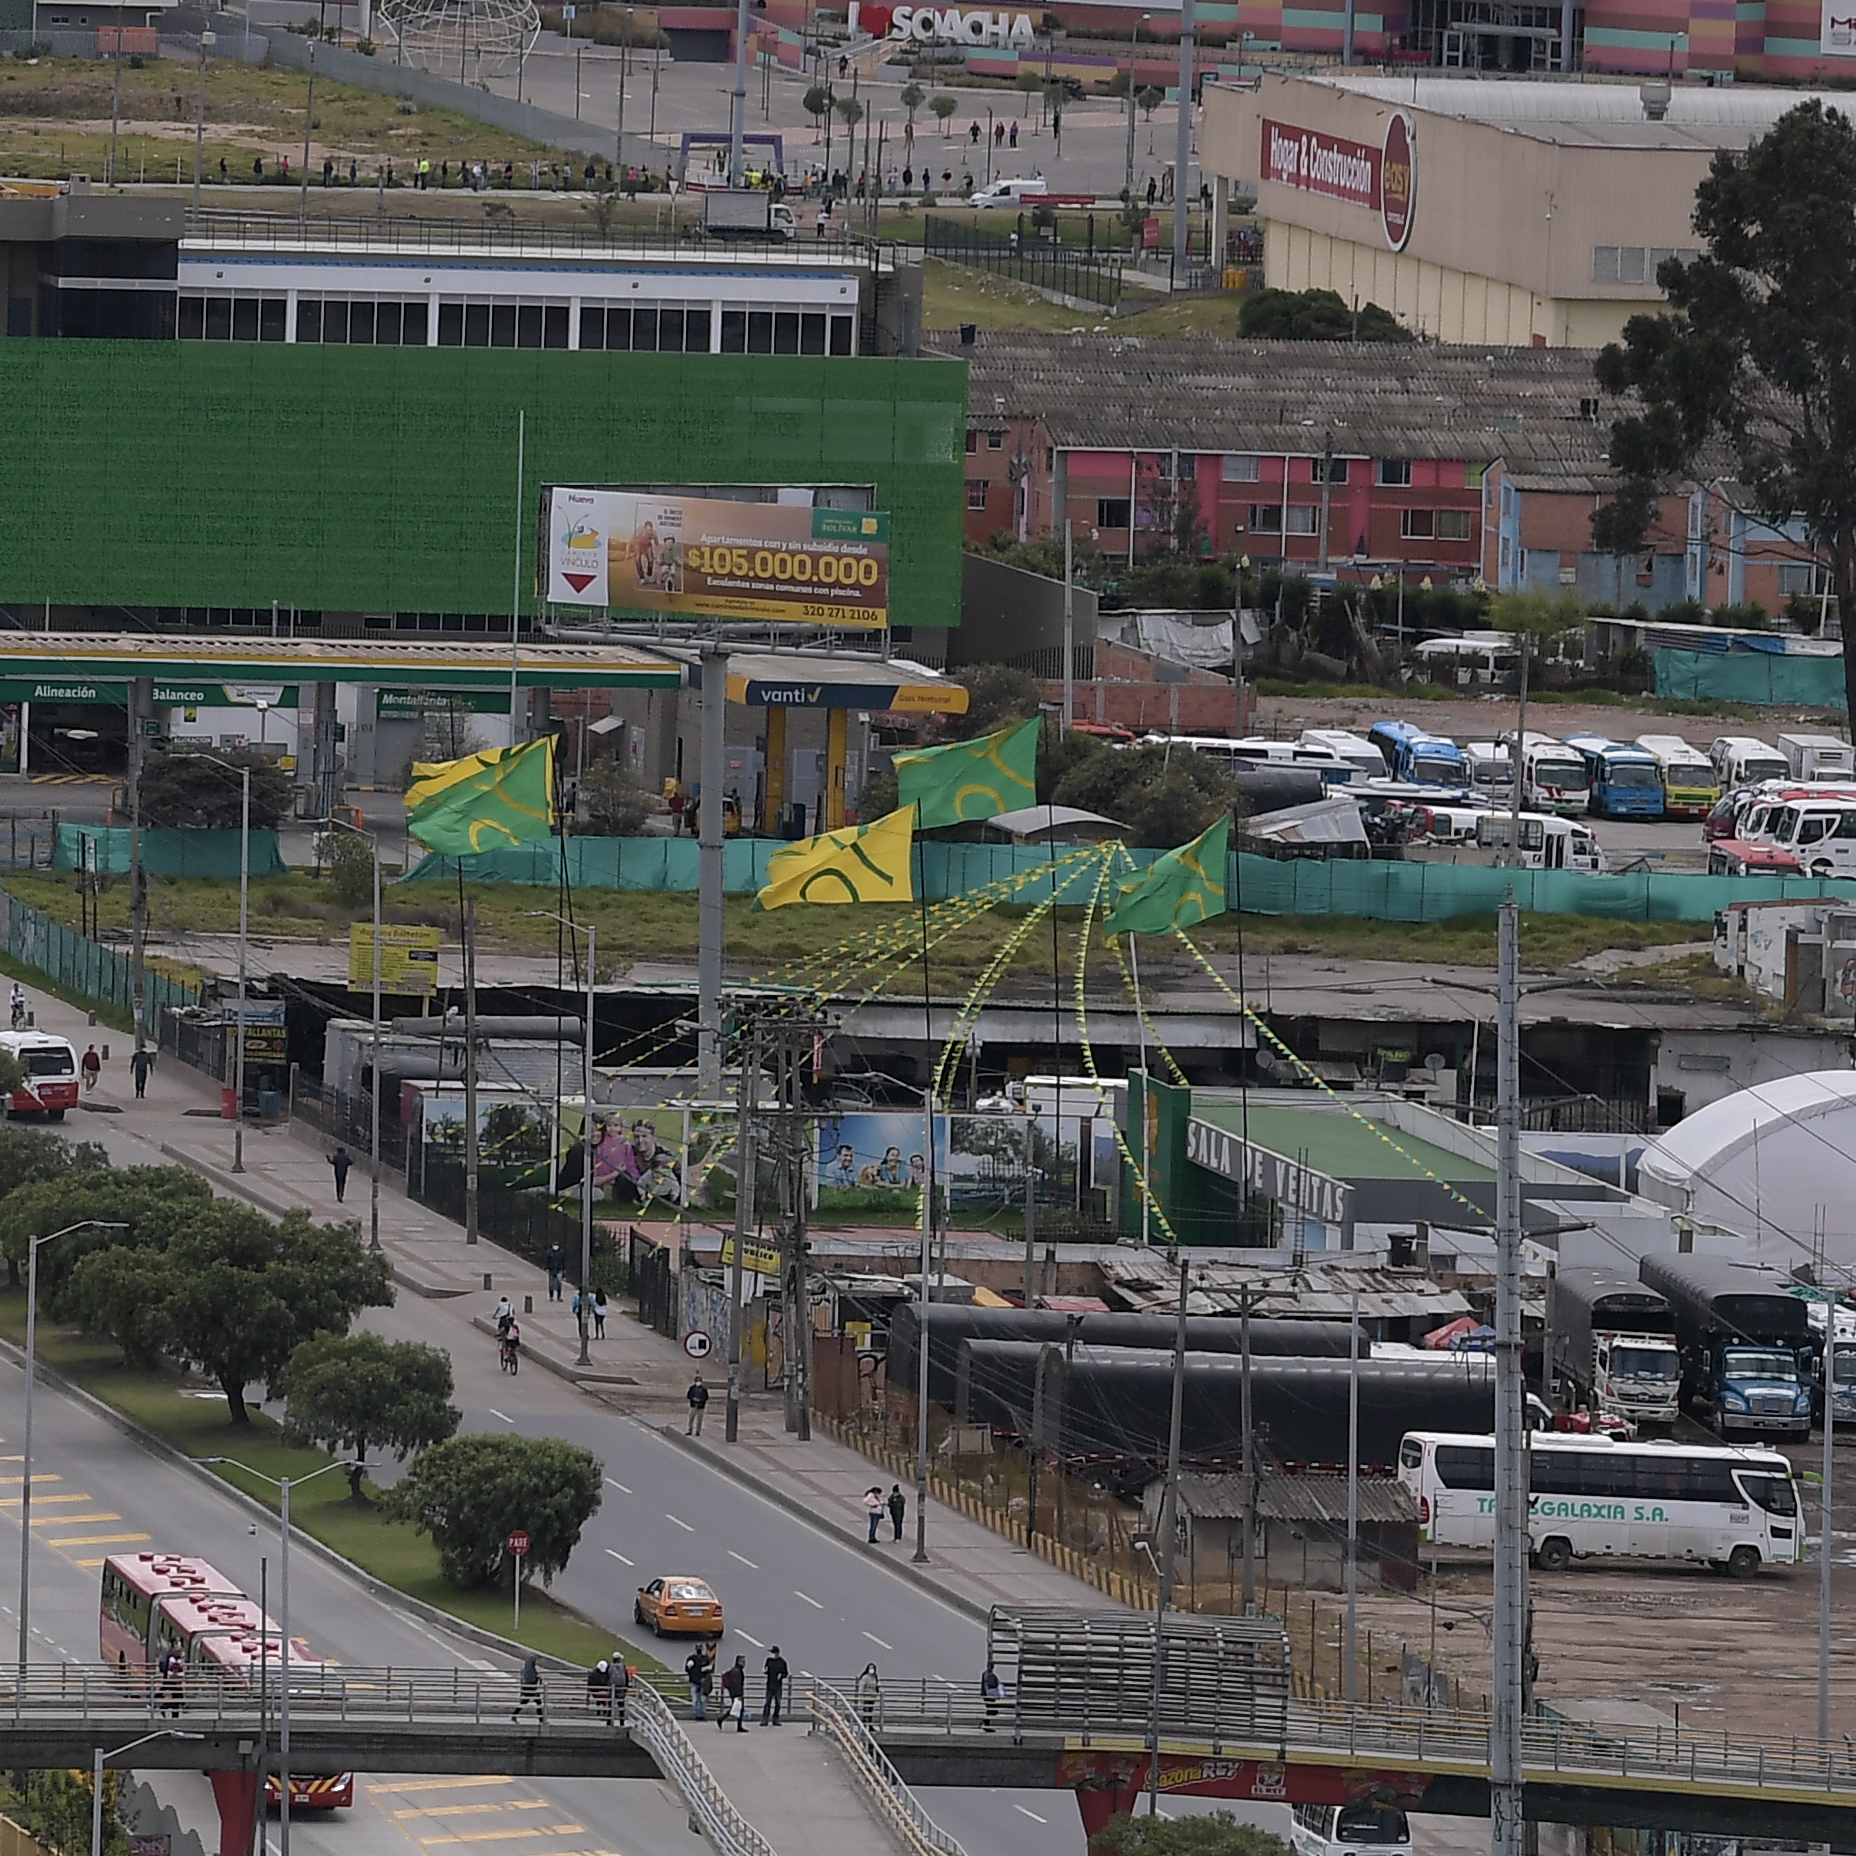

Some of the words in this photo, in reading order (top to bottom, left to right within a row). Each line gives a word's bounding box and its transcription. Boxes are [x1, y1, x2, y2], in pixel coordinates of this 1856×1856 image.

[891, 5, 1035, 47] SOACHA
[1270, 125, 1299, 180] Hogar
[1309, 136, 1372, 194] Construcción
[688, 546, 879, 586] $105.000.000
[802, 605, 825, 617] 320
[828, 607, 846, 619] 271
[849, 608, 879, 622] 2106
[33, 683, 97, 699] Alineación
[760, 688, 806, 703] vanti
[1187, 1121, 1232, 1175] SALA
[1241, 1145, 1264, 1189] DE
[1275, 1159, 1345, 1223] VENTAS
[1633, 1506, 1669, 1522] S.A.
[509, 1537, 528, 1547] PARE
